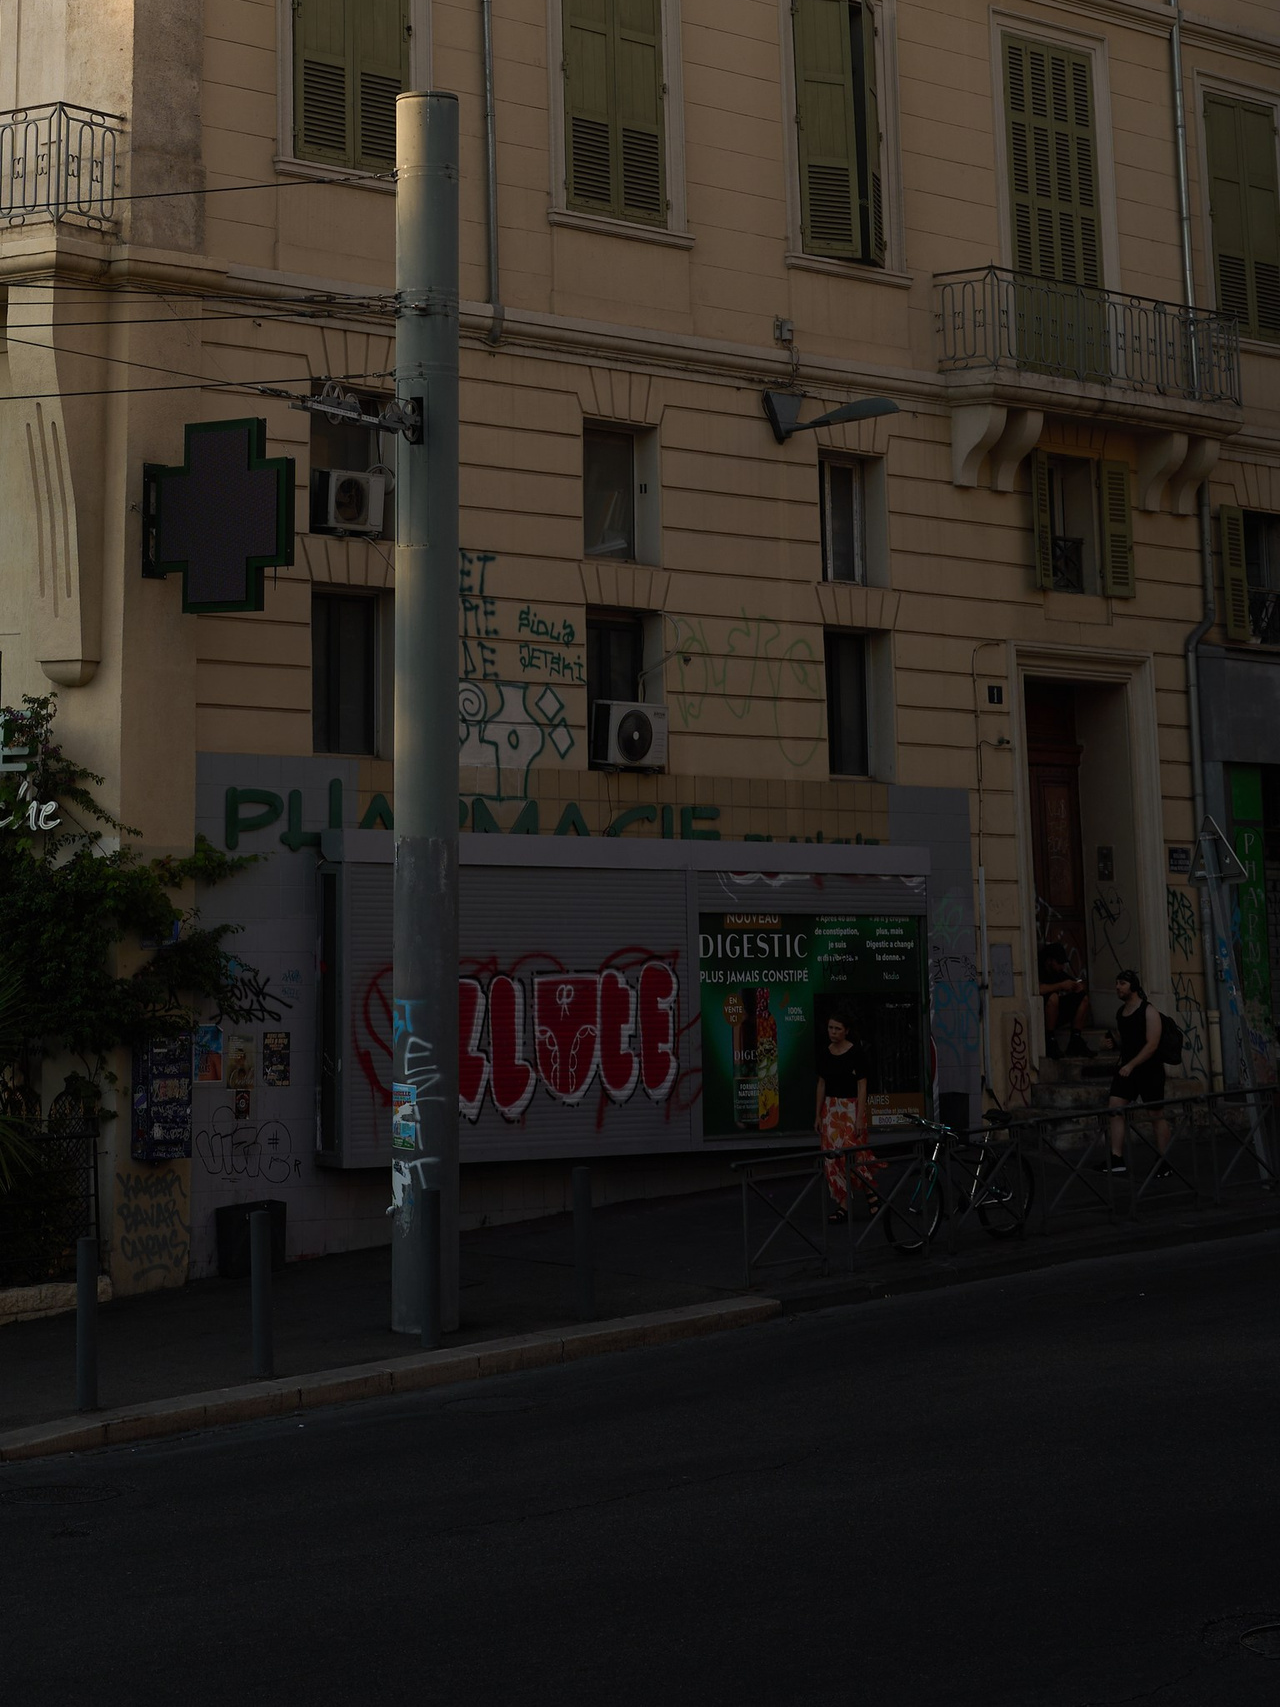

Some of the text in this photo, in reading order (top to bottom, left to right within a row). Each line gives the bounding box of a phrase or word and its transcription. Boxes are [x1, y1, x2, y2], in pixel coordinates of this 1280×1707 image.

[727, 914, 779, 924] NOUVEAU
[814, 927, 859, 936] de constipation,
[875, 927, 904, 936] plus, mais
[699, 933, 809, 959] DIGESTIC
[828, 940, 847, 950] je suis
[866, 940, 889, 950] Digestic
[894, 939, 915, 950] changé
[875, 953, 882, 961] la
[882, 953, 902, 962] donne.
[699, 970, 724, 983] PLUS
[726, 970, 760, 985] JAMAIS
[762, 967, 809, 983] CONSTIPÉ
[729, 997, 737, 1005] EN
[724, 1006, 743, 1014] VENTE
[787, 1007, 803, 1015] 100%
[729, 1015, 738, 1023] ICI
[784, 1014, 806, 1022] NATUREL
